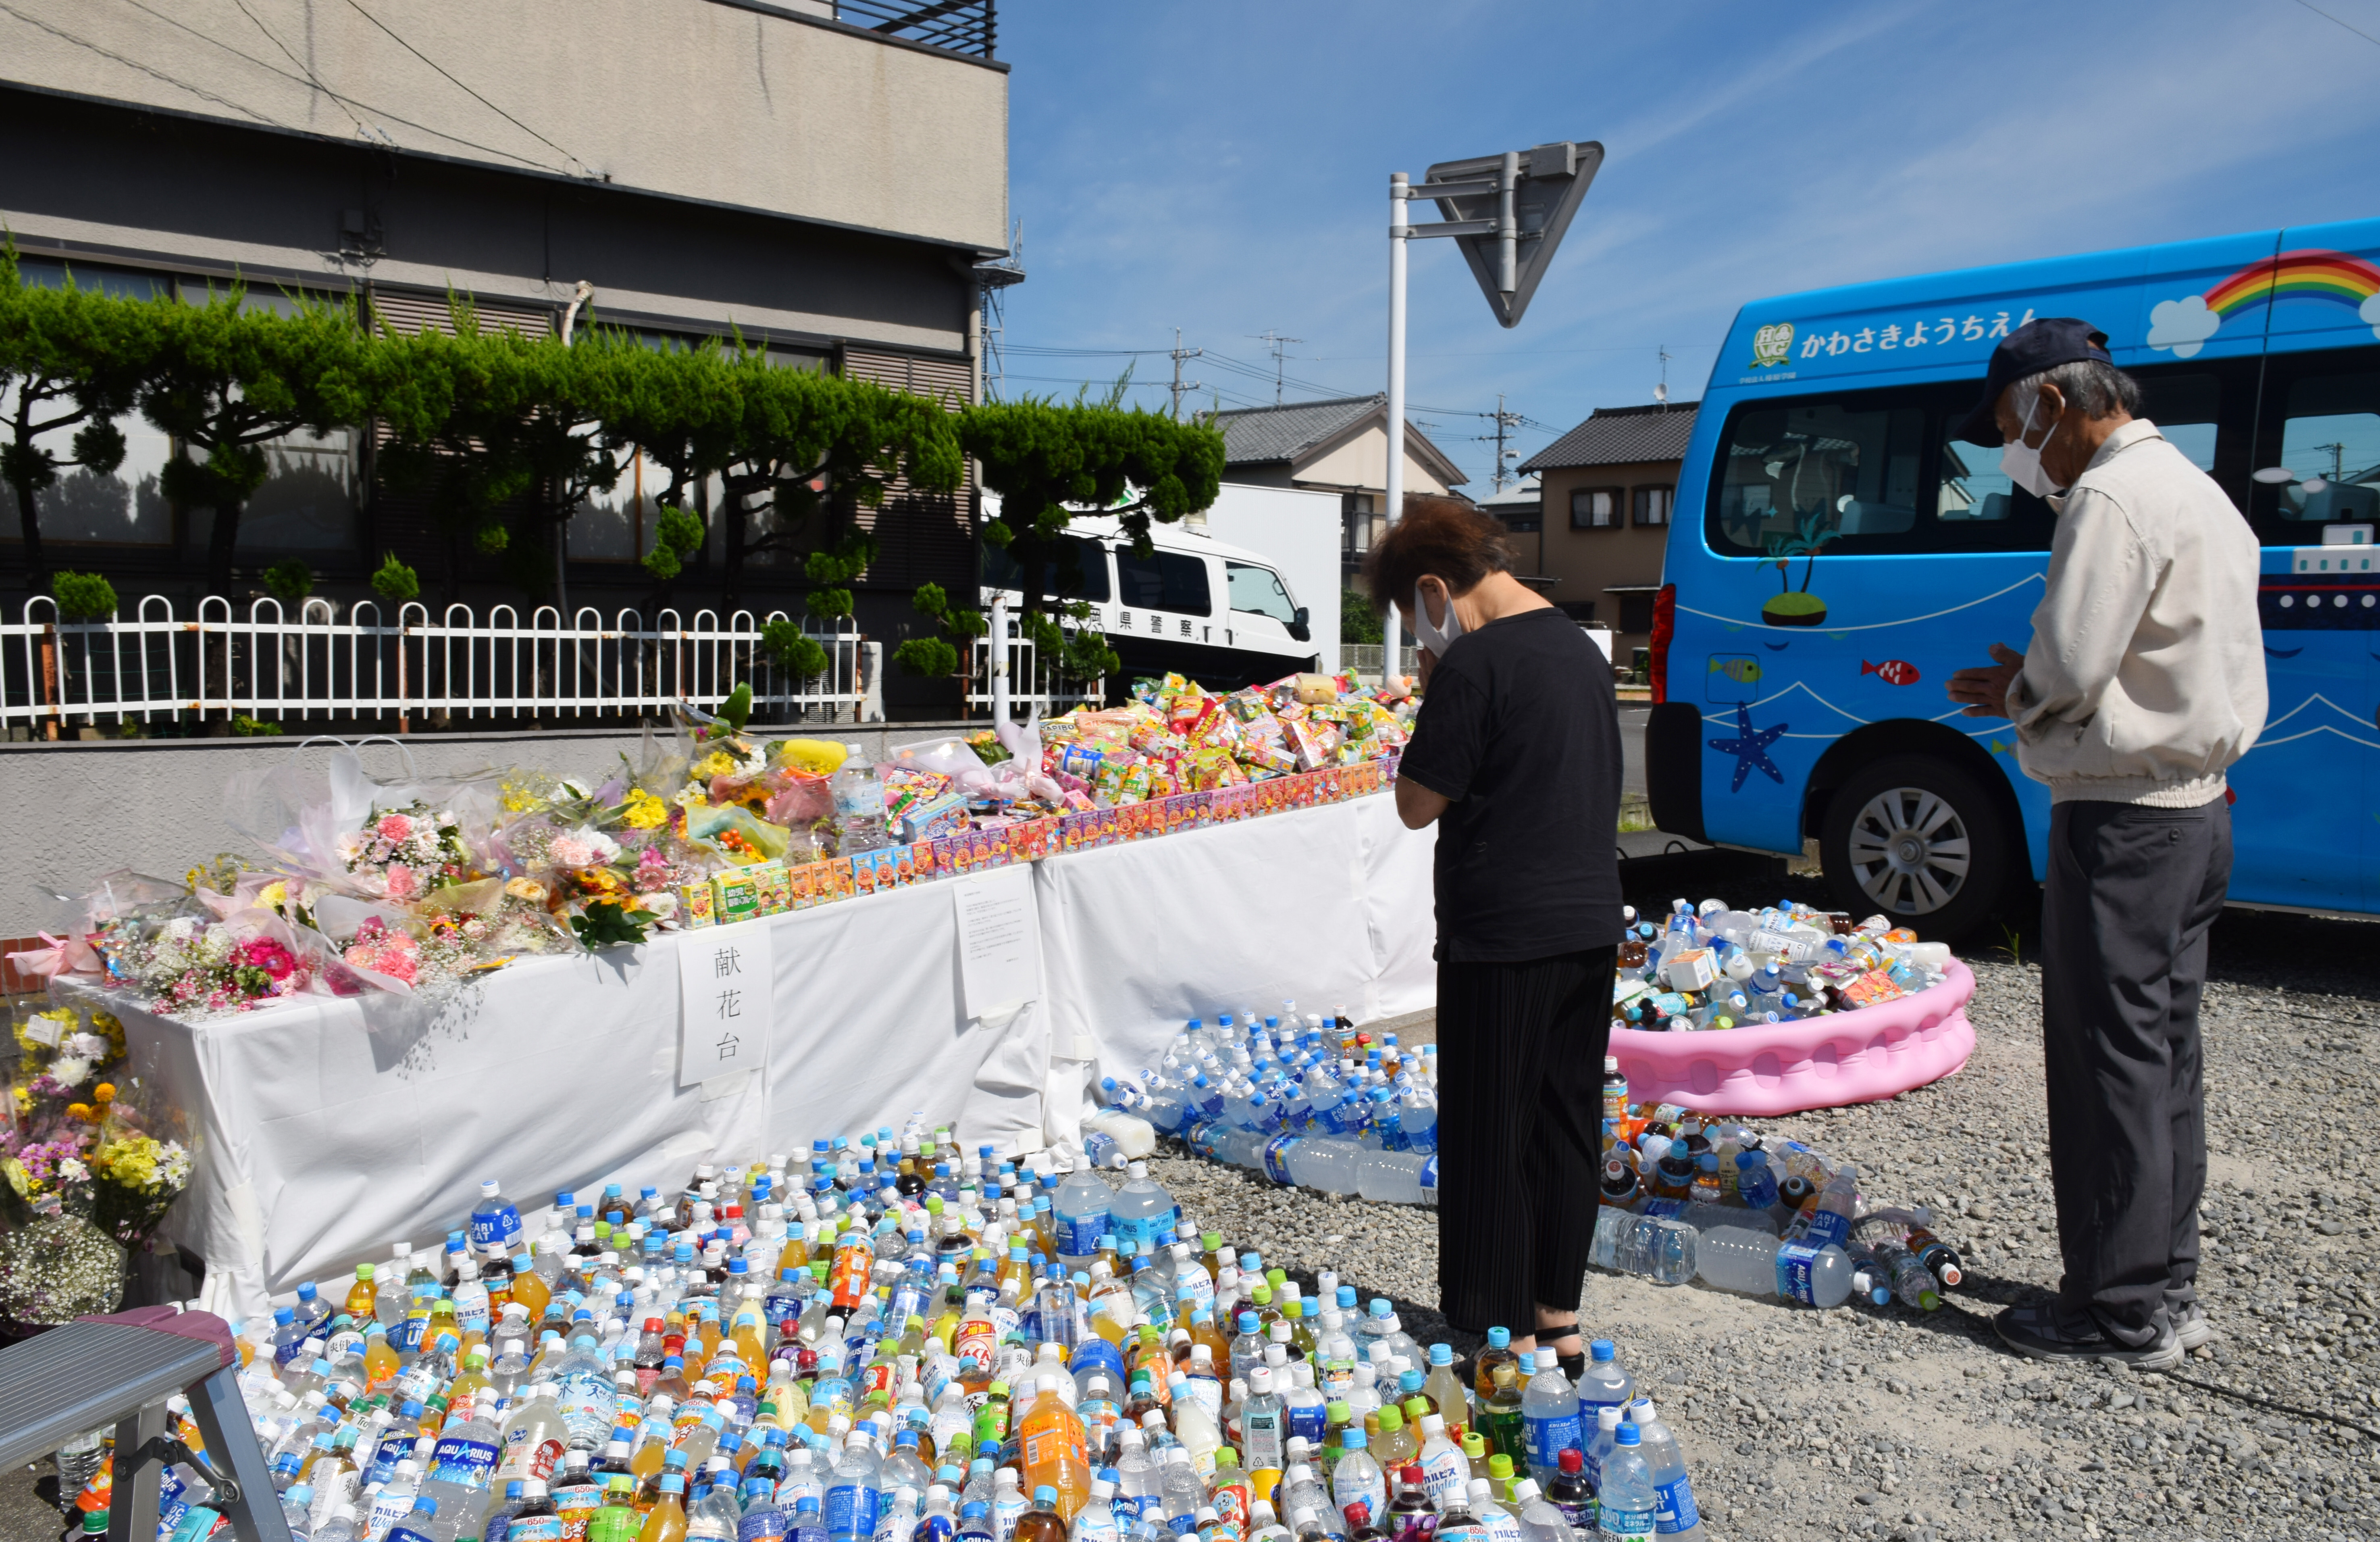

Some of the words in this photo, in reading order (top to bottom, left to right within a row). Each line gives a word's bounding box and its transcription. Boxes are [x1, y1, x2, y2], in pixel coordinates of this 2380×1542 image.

[727, 887, 744, 898] 幼児
[714, 947, 741, 1061] 献花台
[1190, 1279, 1211, 1290] ルピス
[457, 1308, 485, 1318] カルピス
[707, 1359, 726, 1368] 670ml
[593, 1374, 616, 1390] SUNTORY
[586, 1384, 616, 1407] 天然水
[963, 1395, 984, 1417] 茶
[437, 1441, 494, 1463] AQUARIUS
[1564, 1510, 1595, 1523] Welch's
[400, 1534, 422, 1542] AQUA
